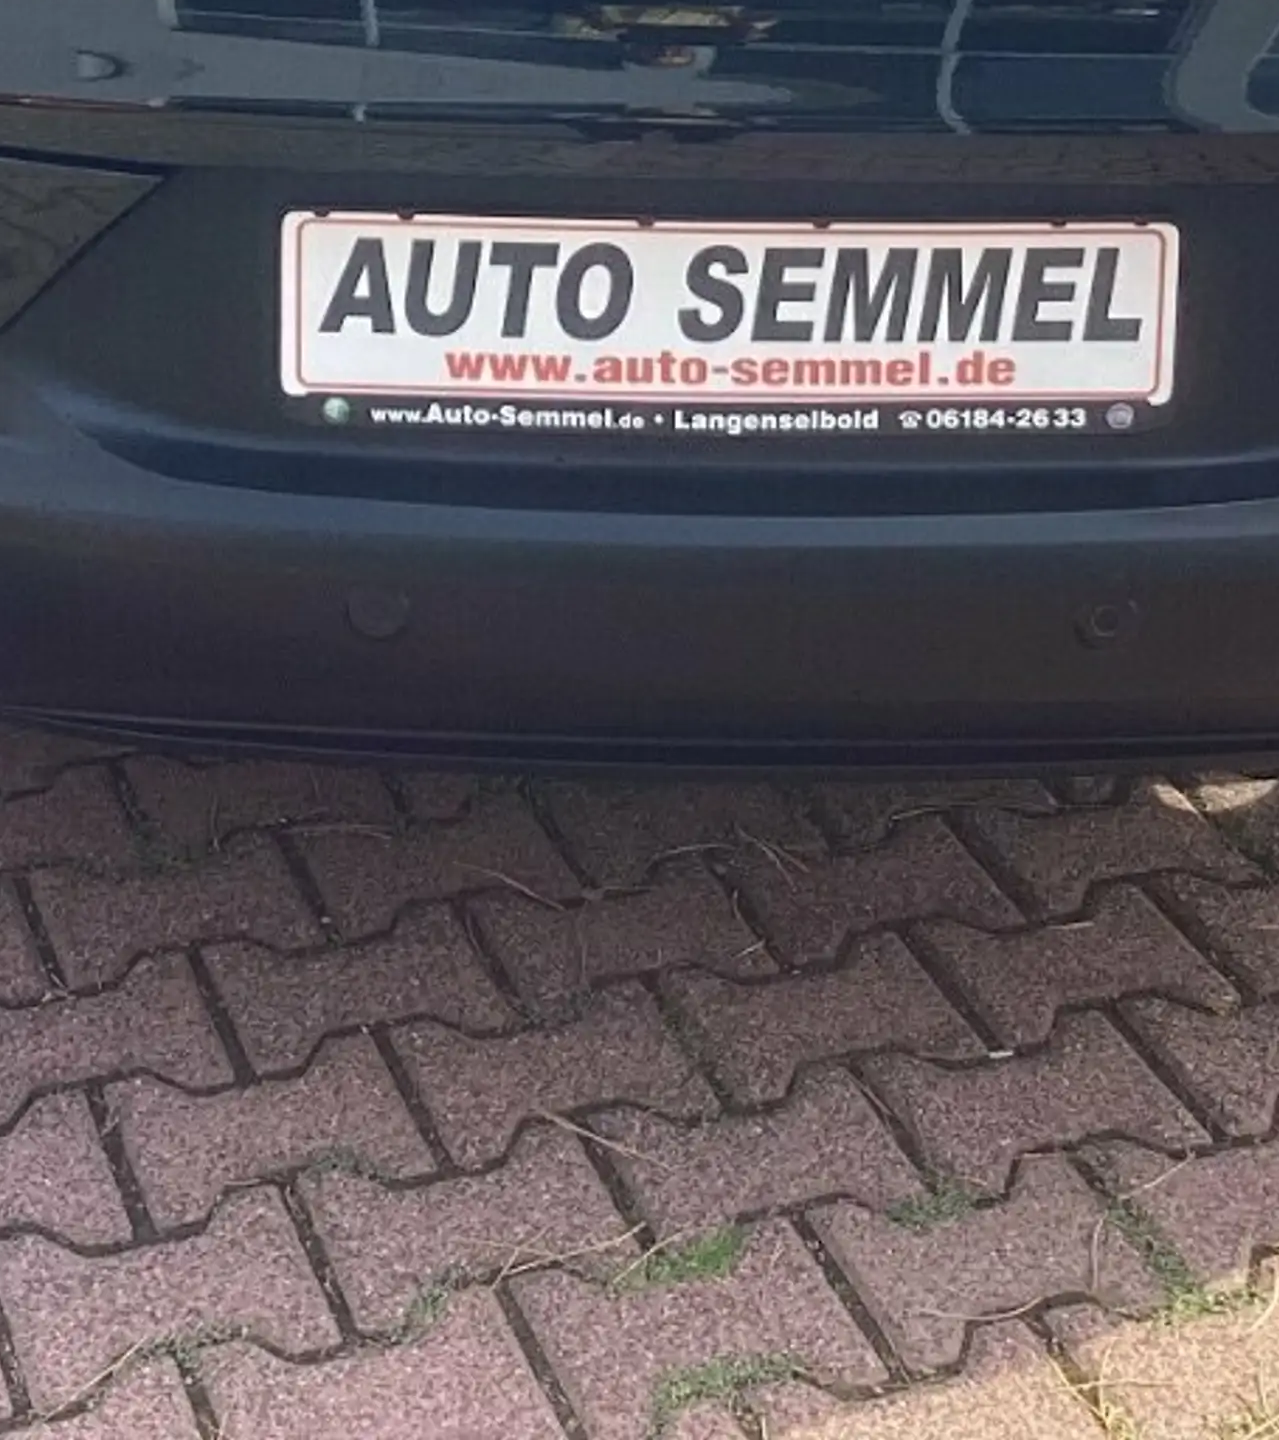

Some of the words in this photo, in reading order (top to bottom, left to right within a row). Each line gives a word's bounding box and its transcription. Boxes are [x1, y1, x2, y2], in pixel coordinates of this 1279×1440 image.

[318, 237, 634, 342] AUTO
[677, 244, 1143, 344] SEMMEL
[444, 350, 1016, 388] www.auto-semmel.de
[370, 401, 646, 430] www.Auto-Semmel.de
[674, 409, 880, 435] Langenselbold
